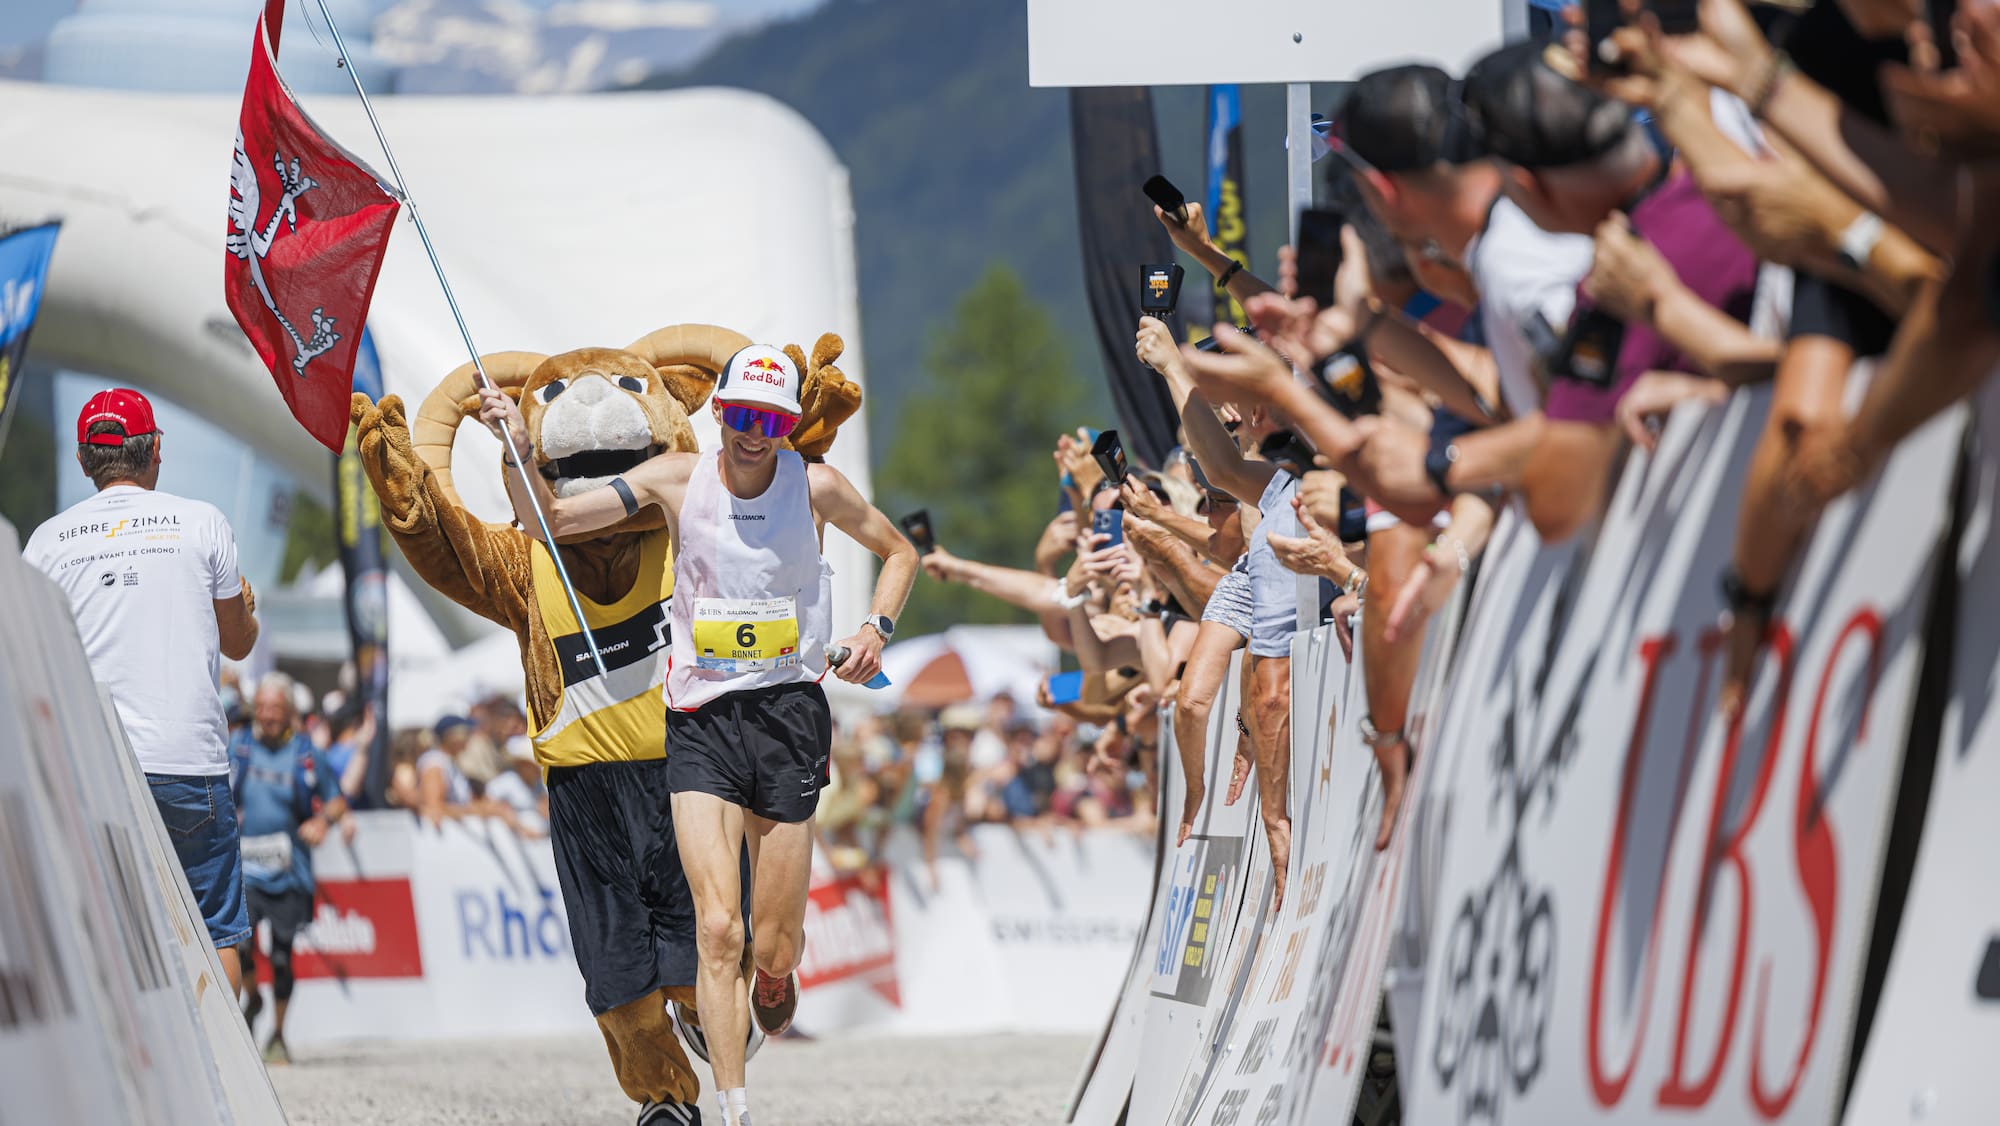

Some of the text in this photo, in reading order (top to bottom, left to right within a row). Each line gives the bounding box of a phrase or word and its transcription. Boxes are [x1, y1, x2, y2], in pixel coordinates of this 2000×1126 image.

[743, 371, 785, 388] Red Bull
[59, 515, 181, 542] SIERRE ZINAL
[71, 556, 95, 566] COEUR
[99, 552, 124, 560] AVANT
[140, 547, 175, 555] CHRONO
[736, 623, 757, 648] 6
[731, 650, 763, 658] BONNET
[1586, 604, 1885, 1120] UBS
